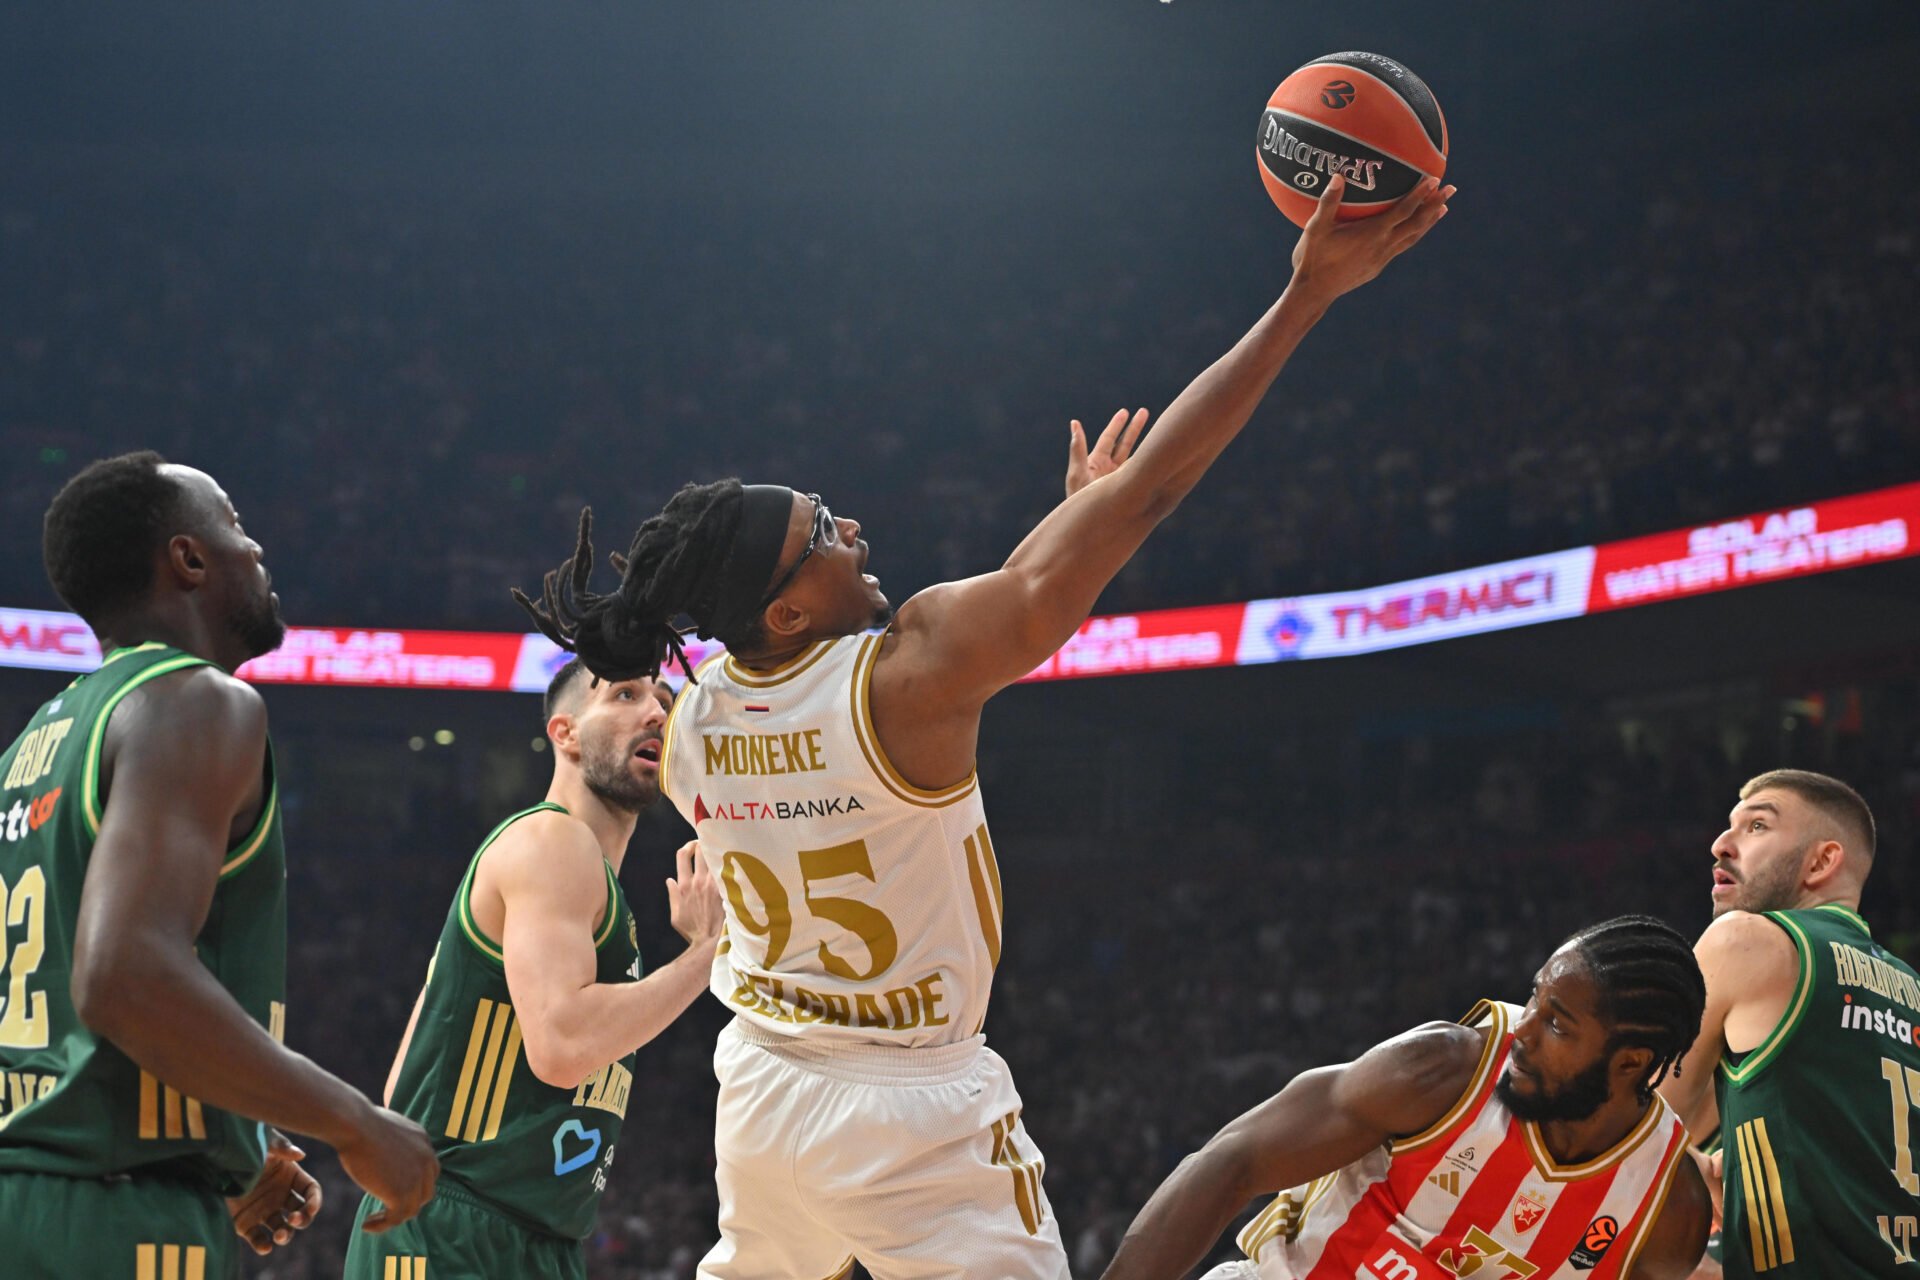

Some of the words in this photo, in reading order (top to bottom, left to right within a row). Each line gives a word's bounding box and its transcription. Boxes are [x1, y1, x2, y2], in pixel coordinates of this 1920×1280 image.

[1263, 115, 1384, 192] SPALDING
[703, 729, 826, 776] MONEKE
[715, 796, 865, 821] ALTABANKA
[721, 838, 898, 982] 95
